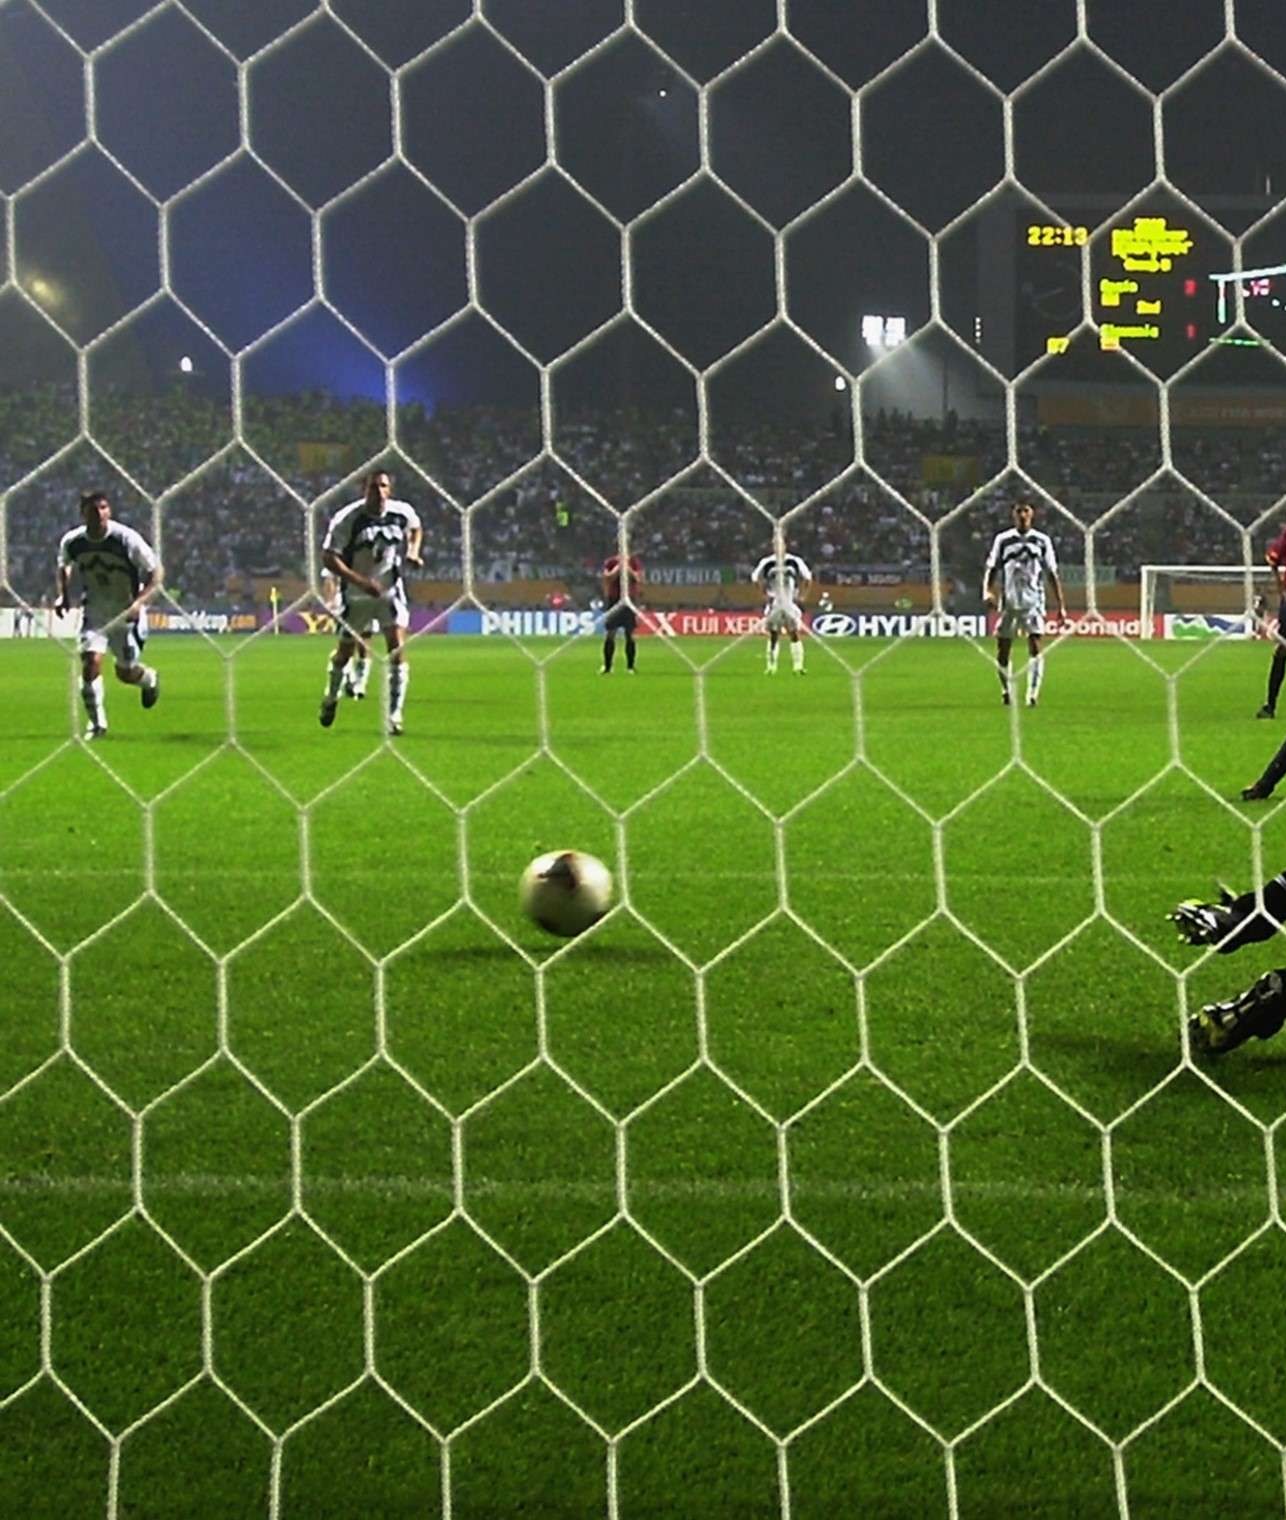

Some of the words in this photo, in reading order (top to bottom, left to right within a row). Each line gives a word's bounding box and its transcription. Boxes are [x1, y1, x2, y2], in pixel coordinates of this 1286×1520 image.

[481, 610, 595, 636] PHILIPS
[683, 616, 719, 635] FUJI
[858, 614, 986, 637] HYUNDAI
